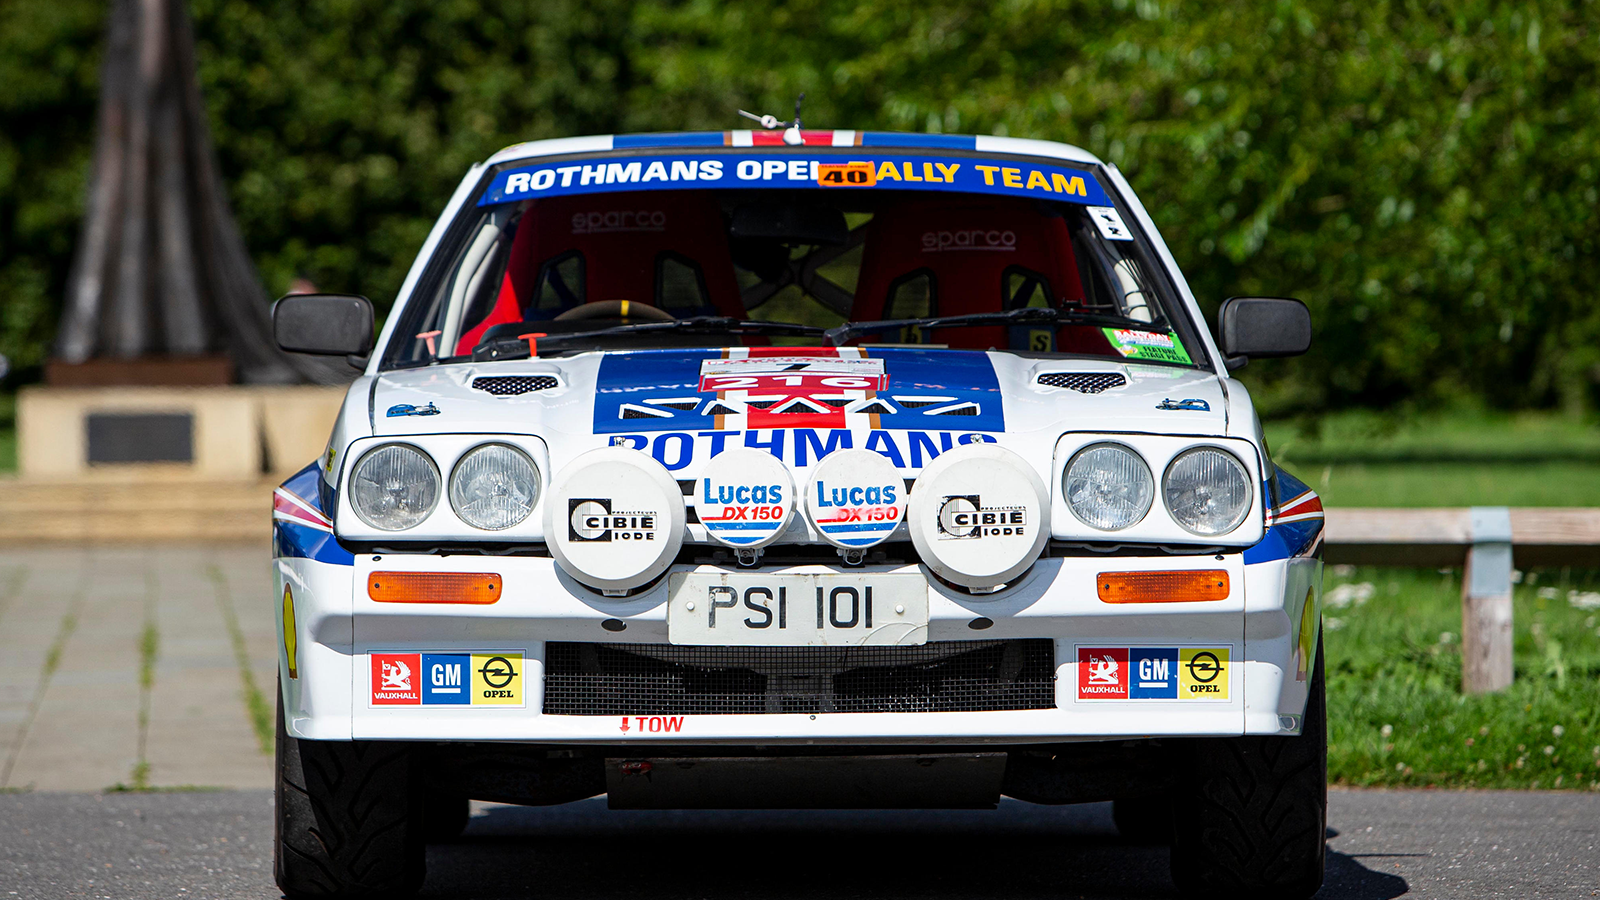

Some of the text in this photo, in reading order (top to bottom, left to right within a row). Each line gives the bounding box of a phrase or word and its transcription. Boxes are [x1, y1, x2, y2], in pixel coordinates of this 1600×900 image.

[505, 160, 723, 194] ROTHMANS
[848, 161, 960, 183] ALLY
[975, 165, 1087, 197] TEAM
[823, 170, 868, 183] 40
[572, 210, 666, 233] sparco
[922, 230, 1017, 251] sparco
[711, 376, 871, 389] 216
[608, 429, 997, 471] OTHMAN
[704, 478, 782, 504] Lucas
[816, 480, 896, 507] Lucas
[722, 506, 784, 520] DX 150
[614, 532, 654, 540] IODE
[984, 527, 1024, 536] IODE
[708, 586, 873, 629] PSI 101
[431, 664, 461, 686] GM
[1139, 658, 1168, 681] GM
[483, 690, 514, 698] OPEL
[1081, 686, 1125, 694] VAUXHALL
[635, 716, 684, 732] TOW
